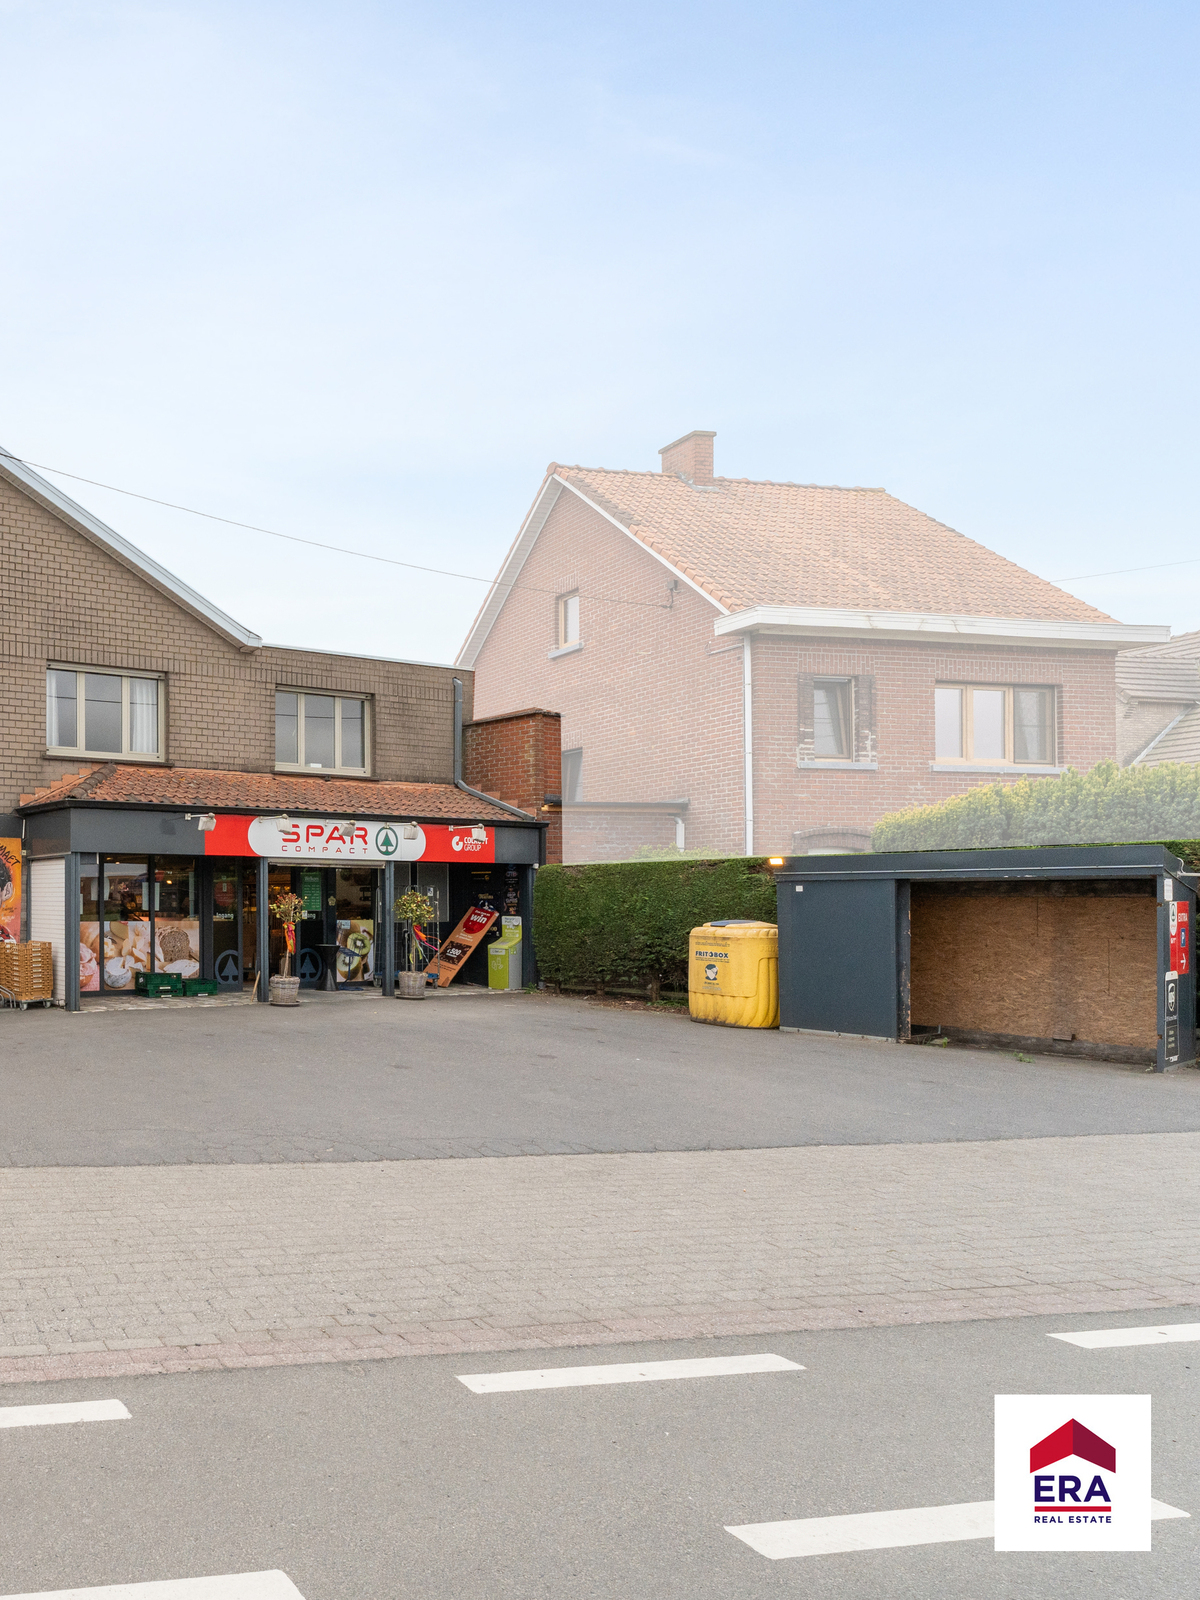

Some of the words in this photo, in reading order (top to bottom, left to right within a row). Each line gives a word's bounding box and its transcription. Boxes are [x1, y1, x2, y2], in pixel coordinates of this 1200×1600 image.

[281, 824, 368, 845] SPAR
[281, 845, 368, 854] COMPACT
[464, 844, 481, 852] GROUP
[470, 914, 487, 924] win
